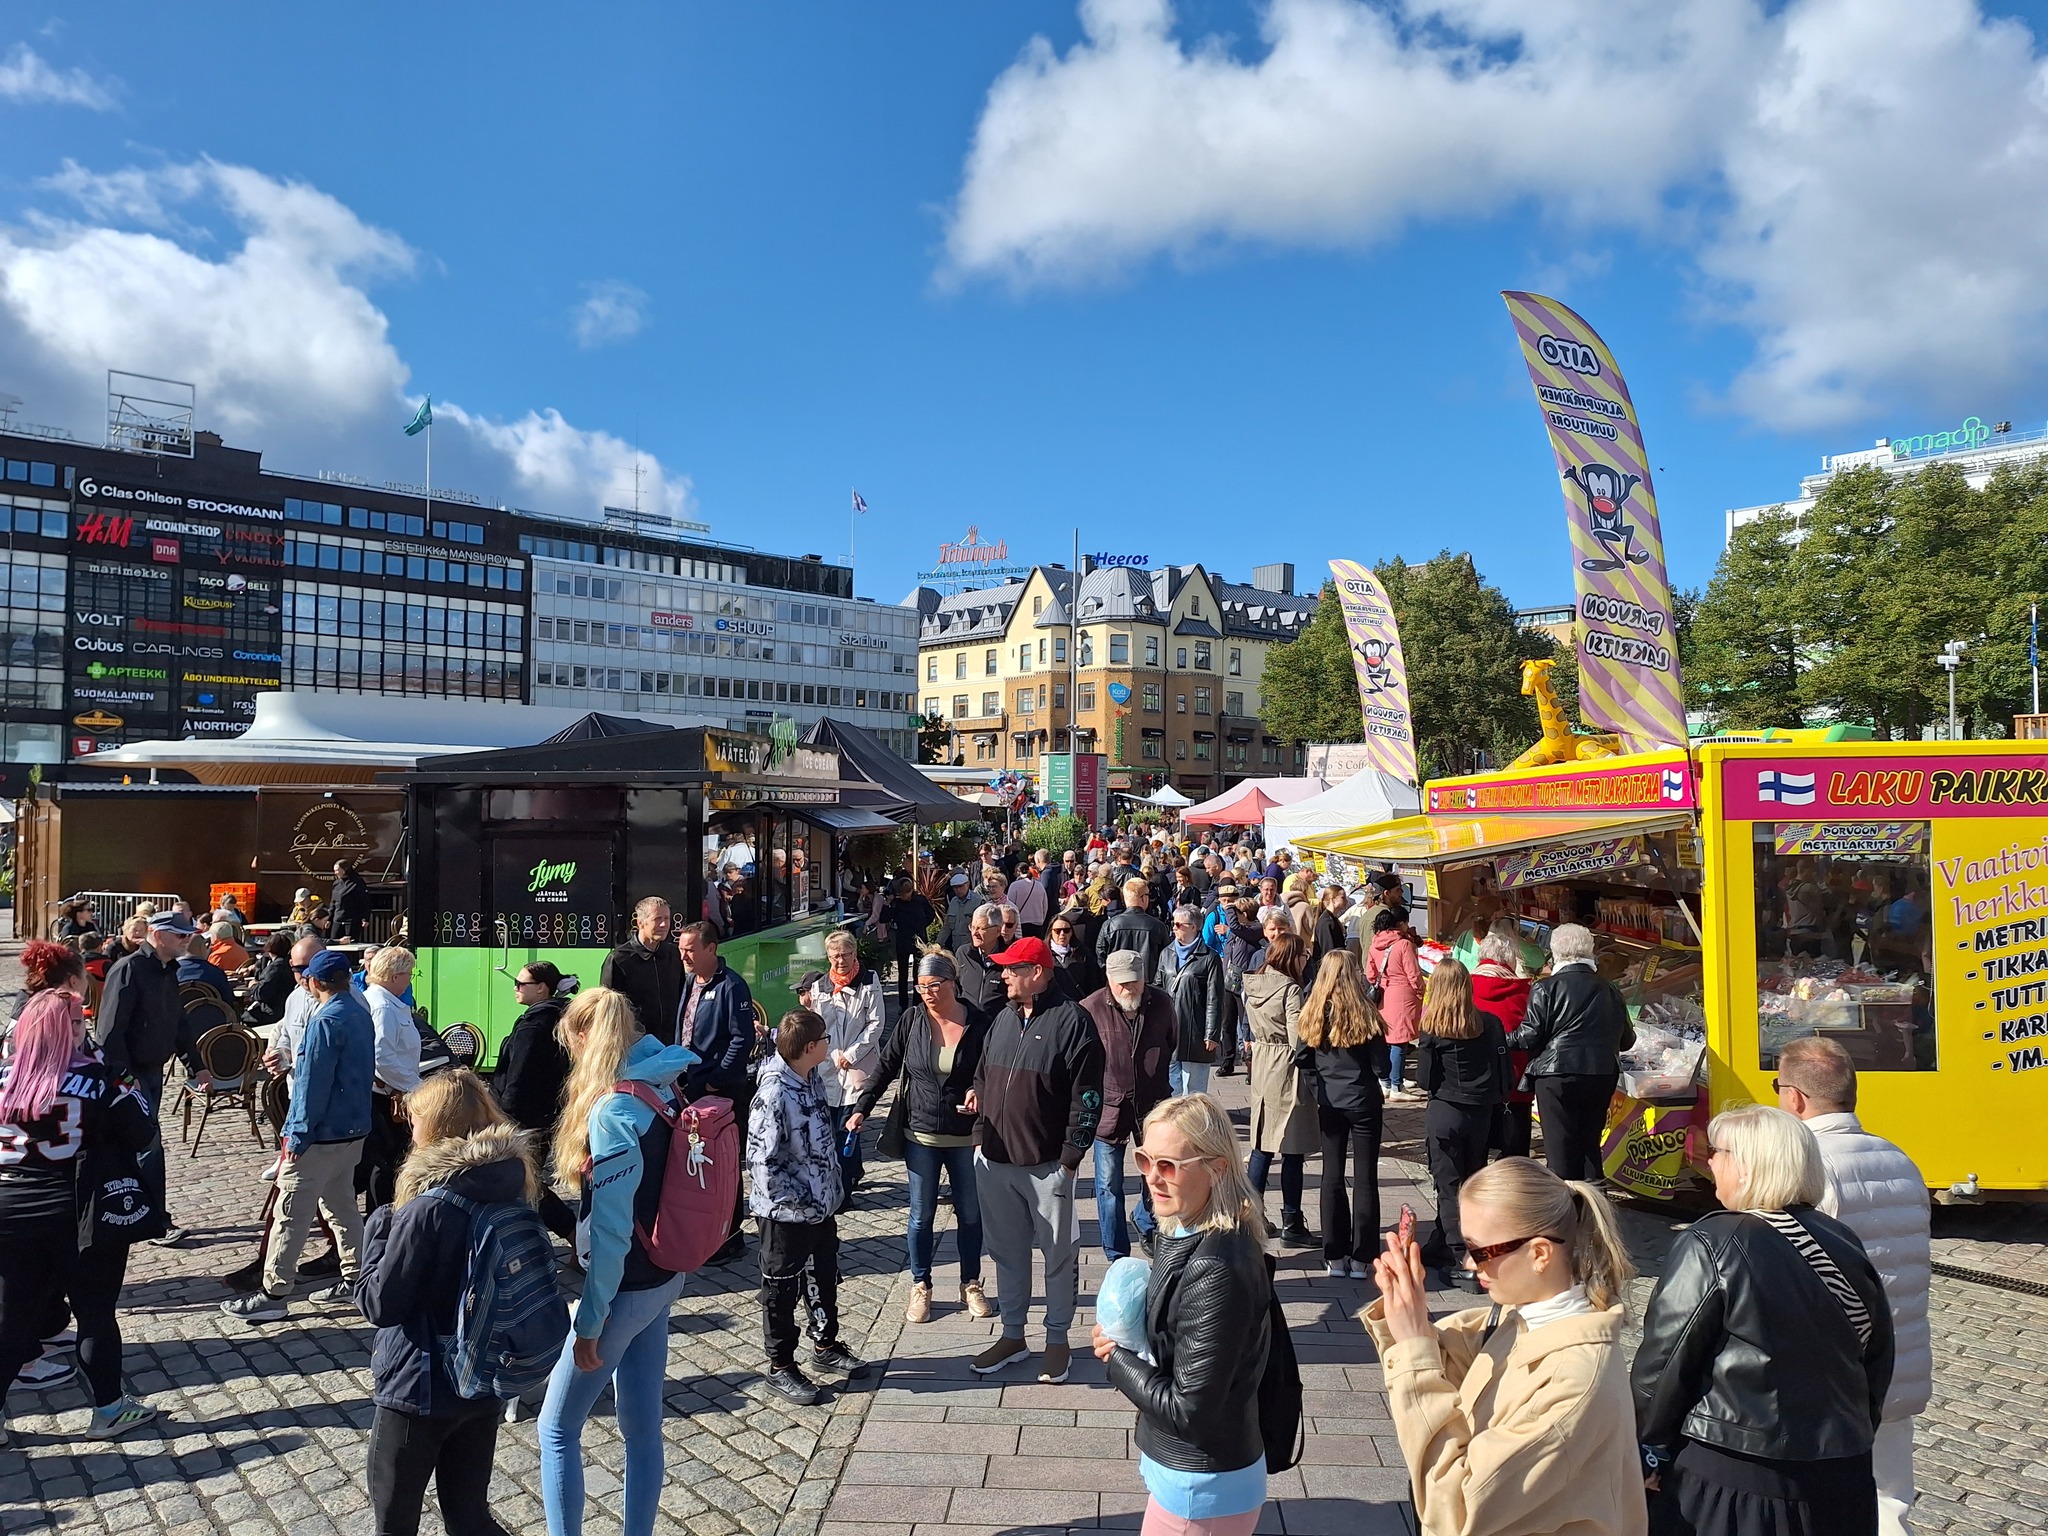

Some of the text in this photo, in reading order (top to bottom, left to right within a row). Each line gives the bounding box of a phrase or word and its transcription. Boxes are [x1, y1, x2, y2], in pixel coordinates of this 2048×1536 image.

[101, 486, 182, 505] Clas Ohlson
[187, 498, 284, 520] STOCKMANN
[76, 513, 134, 548] H&M
[145, 519, 221, 537] MOOMIN SHOP
[156, 545, 176, 556] DNA
[385, 539, 512, 565] ESTETIIKKA MANSUROW
[937, 538, 1008, 567] Triumph
[1092, 551, 1149, 566] Heeros
[235, 555, 286, 568] VAURAUS
[89, 564, 168, 580] marimekko
[199, 577, 271, 592] TACO BELL
[76, 612, 124, 626] VOLT
[654, 613, 693, 628] anders
[727, 620, 775, 635] SHUUP
[75, 637, 124, 652] Cubus
[840, 632, 889, 649] stadium
[133, 643, 223, 658] CARLINGS
[108, 667, 166, 679] APTEEKKI
[183, 672, 279, 686] ÅBO UNDERRÄTTELSER
[73, 688, 154, 701] SUOMALAINEN
[233, 701, 257, 709] ITSU
[194, 721, 252, 732] NORTHCR
[715, 742, 760, 764] JÄÄTELÖÄ
[802, 756, 834, 771] ICE CREAM
[1536, 780, 1573, 807] TUORETTA
[1575, 772, 1660, 806] METRILAKRITSAA
[1828, 769, 2048, 806] LAKU PAIKK
[1822, 825, 1878, 837] PORVOON
[1802, 839, 1898, 851] METRILAKRITSI
[1540, 844, 1594, 863] PORVOON
[527, 859, 577, 892] Jymy
[1523, 854, 1615, 881] METRILAKRITSI
[1974, 917, 2048, 952] METRI
[1991, 981, 2048, 1012] TUTT
[2000, 1013, 2048, 1043] KAR
[1626, 1126, 1688, 1165] PORVOO
[593, 1164, 637, 1190] NAFIT
